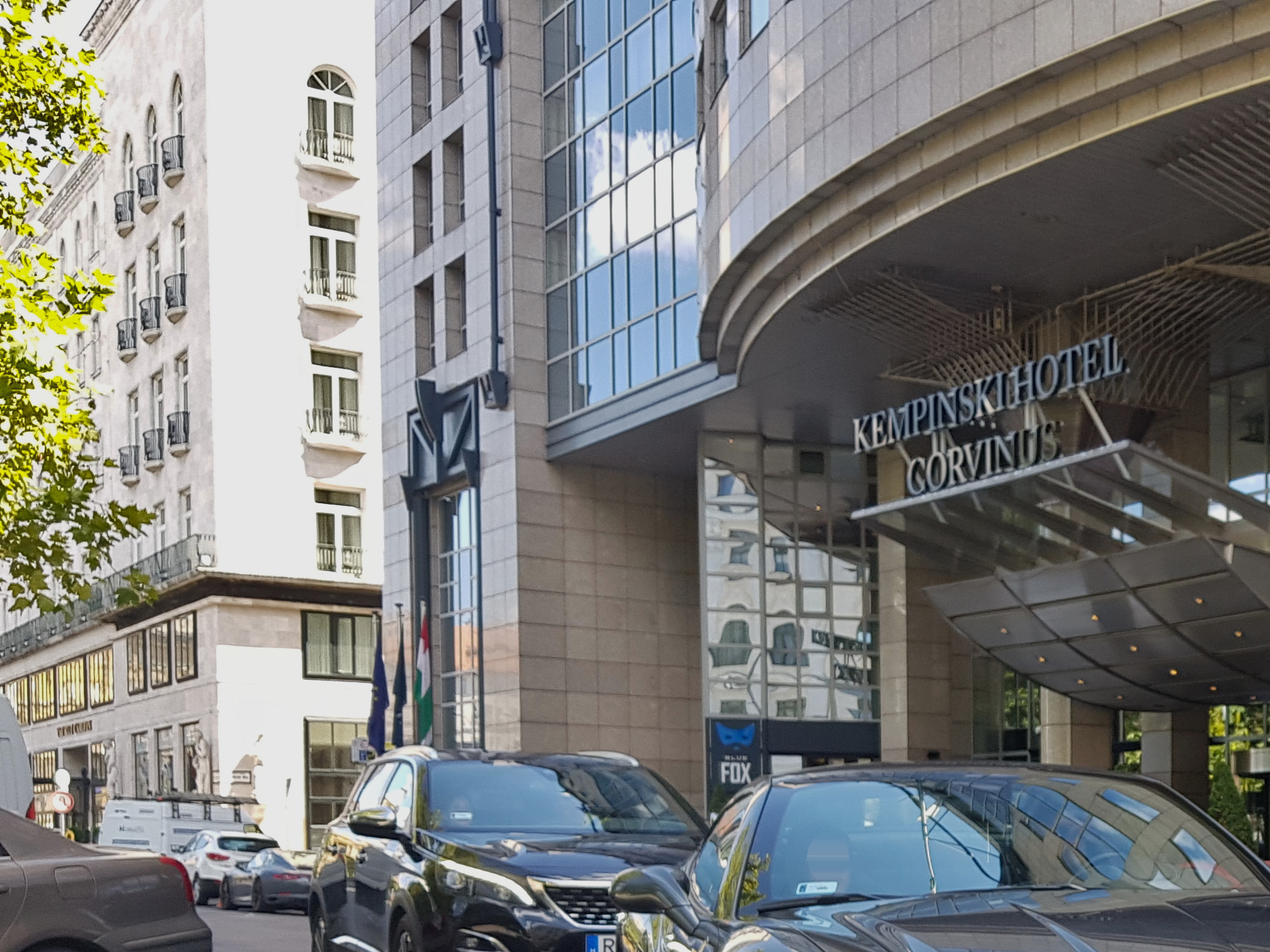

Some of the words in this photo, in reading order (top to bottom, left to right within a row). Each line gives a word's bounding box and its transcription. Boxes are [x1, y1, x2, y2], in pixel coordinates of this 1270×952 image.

[853, 371, 1010, 454] KEMPINSKI
[1011, 333, 1129, 408] HOTEL
[906, 420, 1061, 496] CORVINUS
[720, 761, 752, 784] FOX
